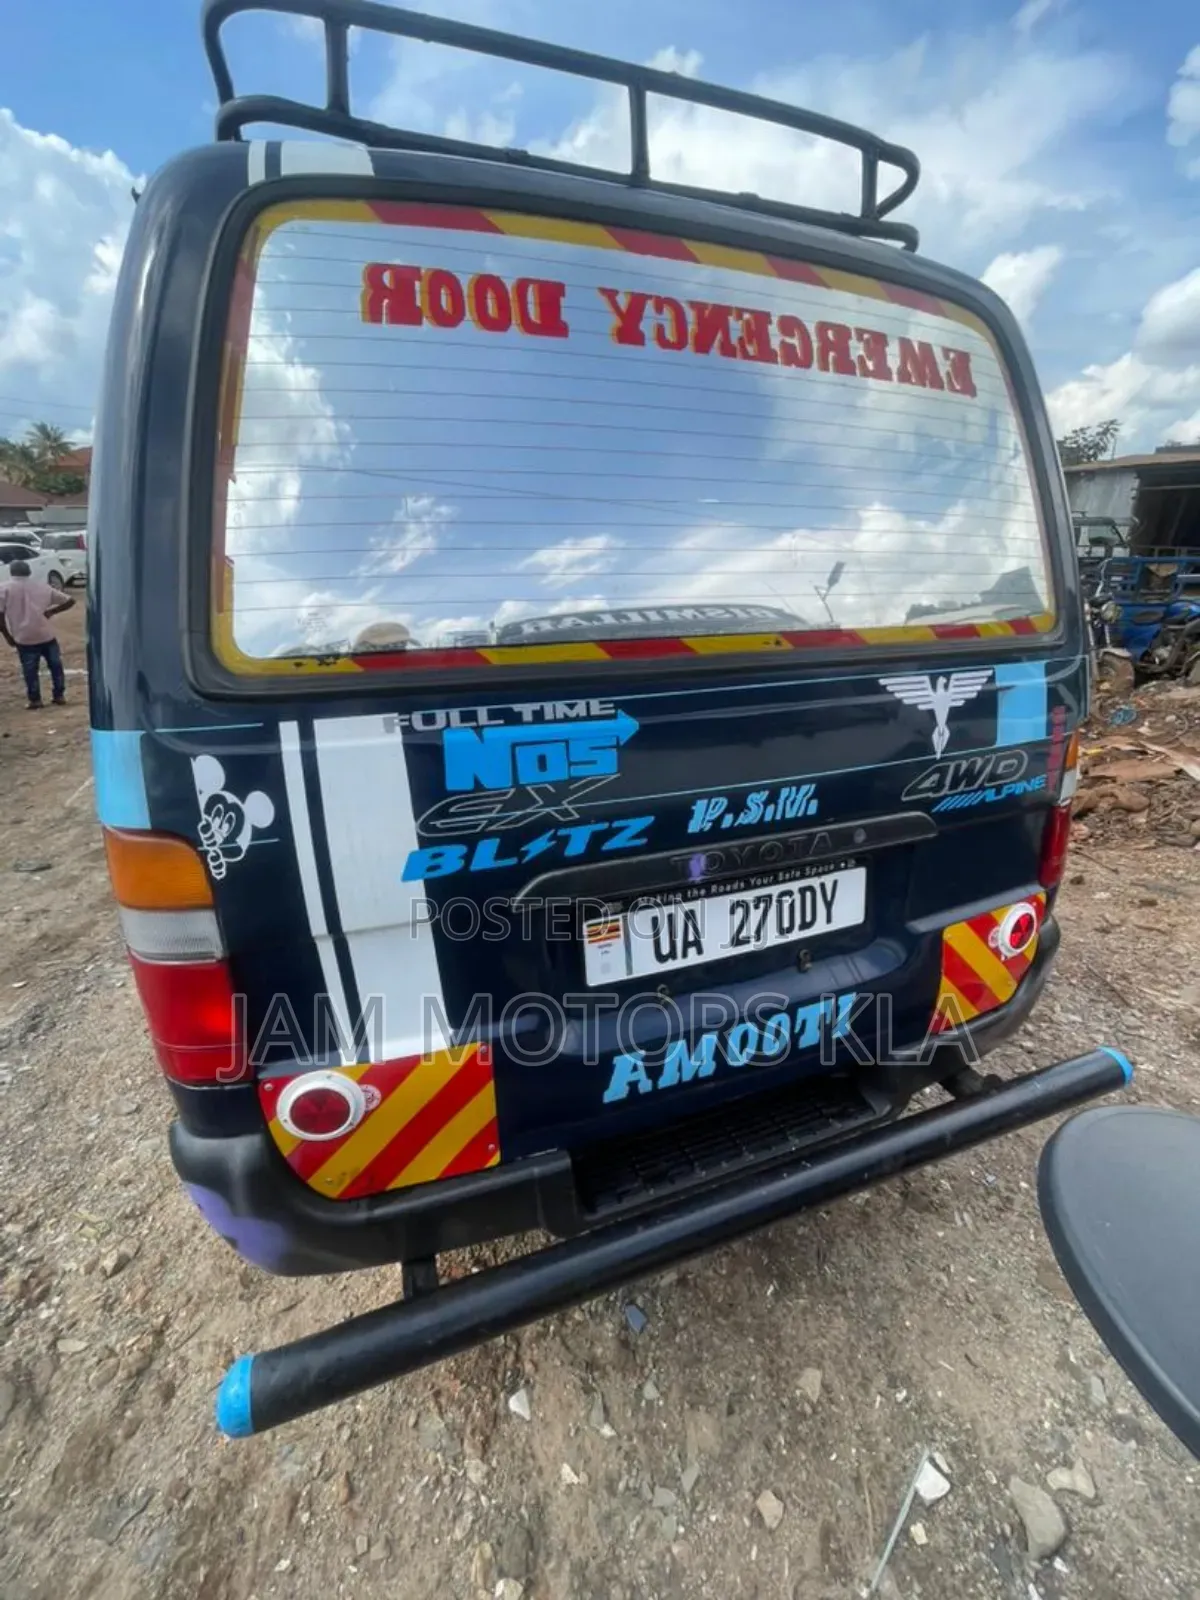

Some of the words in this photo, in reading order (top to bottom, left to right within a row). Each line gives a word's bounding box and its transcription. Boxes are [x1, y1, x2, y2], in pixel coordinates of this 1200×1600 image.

[383, 704, 504, 734] FULL
[511, 699, 616, 724] TIME
[442, 714, 624, 791] NOS
[901, 749, 1029, 802] 4WD
[669, 831, 833, 877] TOYOTA
[687, 885, 707, 899] the
[711, 880, 745, 894] Roads
[750, 874, 774, 888] Your
[778, 869, 801, 883] Safe
[805, 863, 835, 877] Space
[651, 908, 704, 965] UA
[728, 878, 839, 948] 270DY
[602, 992, 858, 1104] AMOOTI
